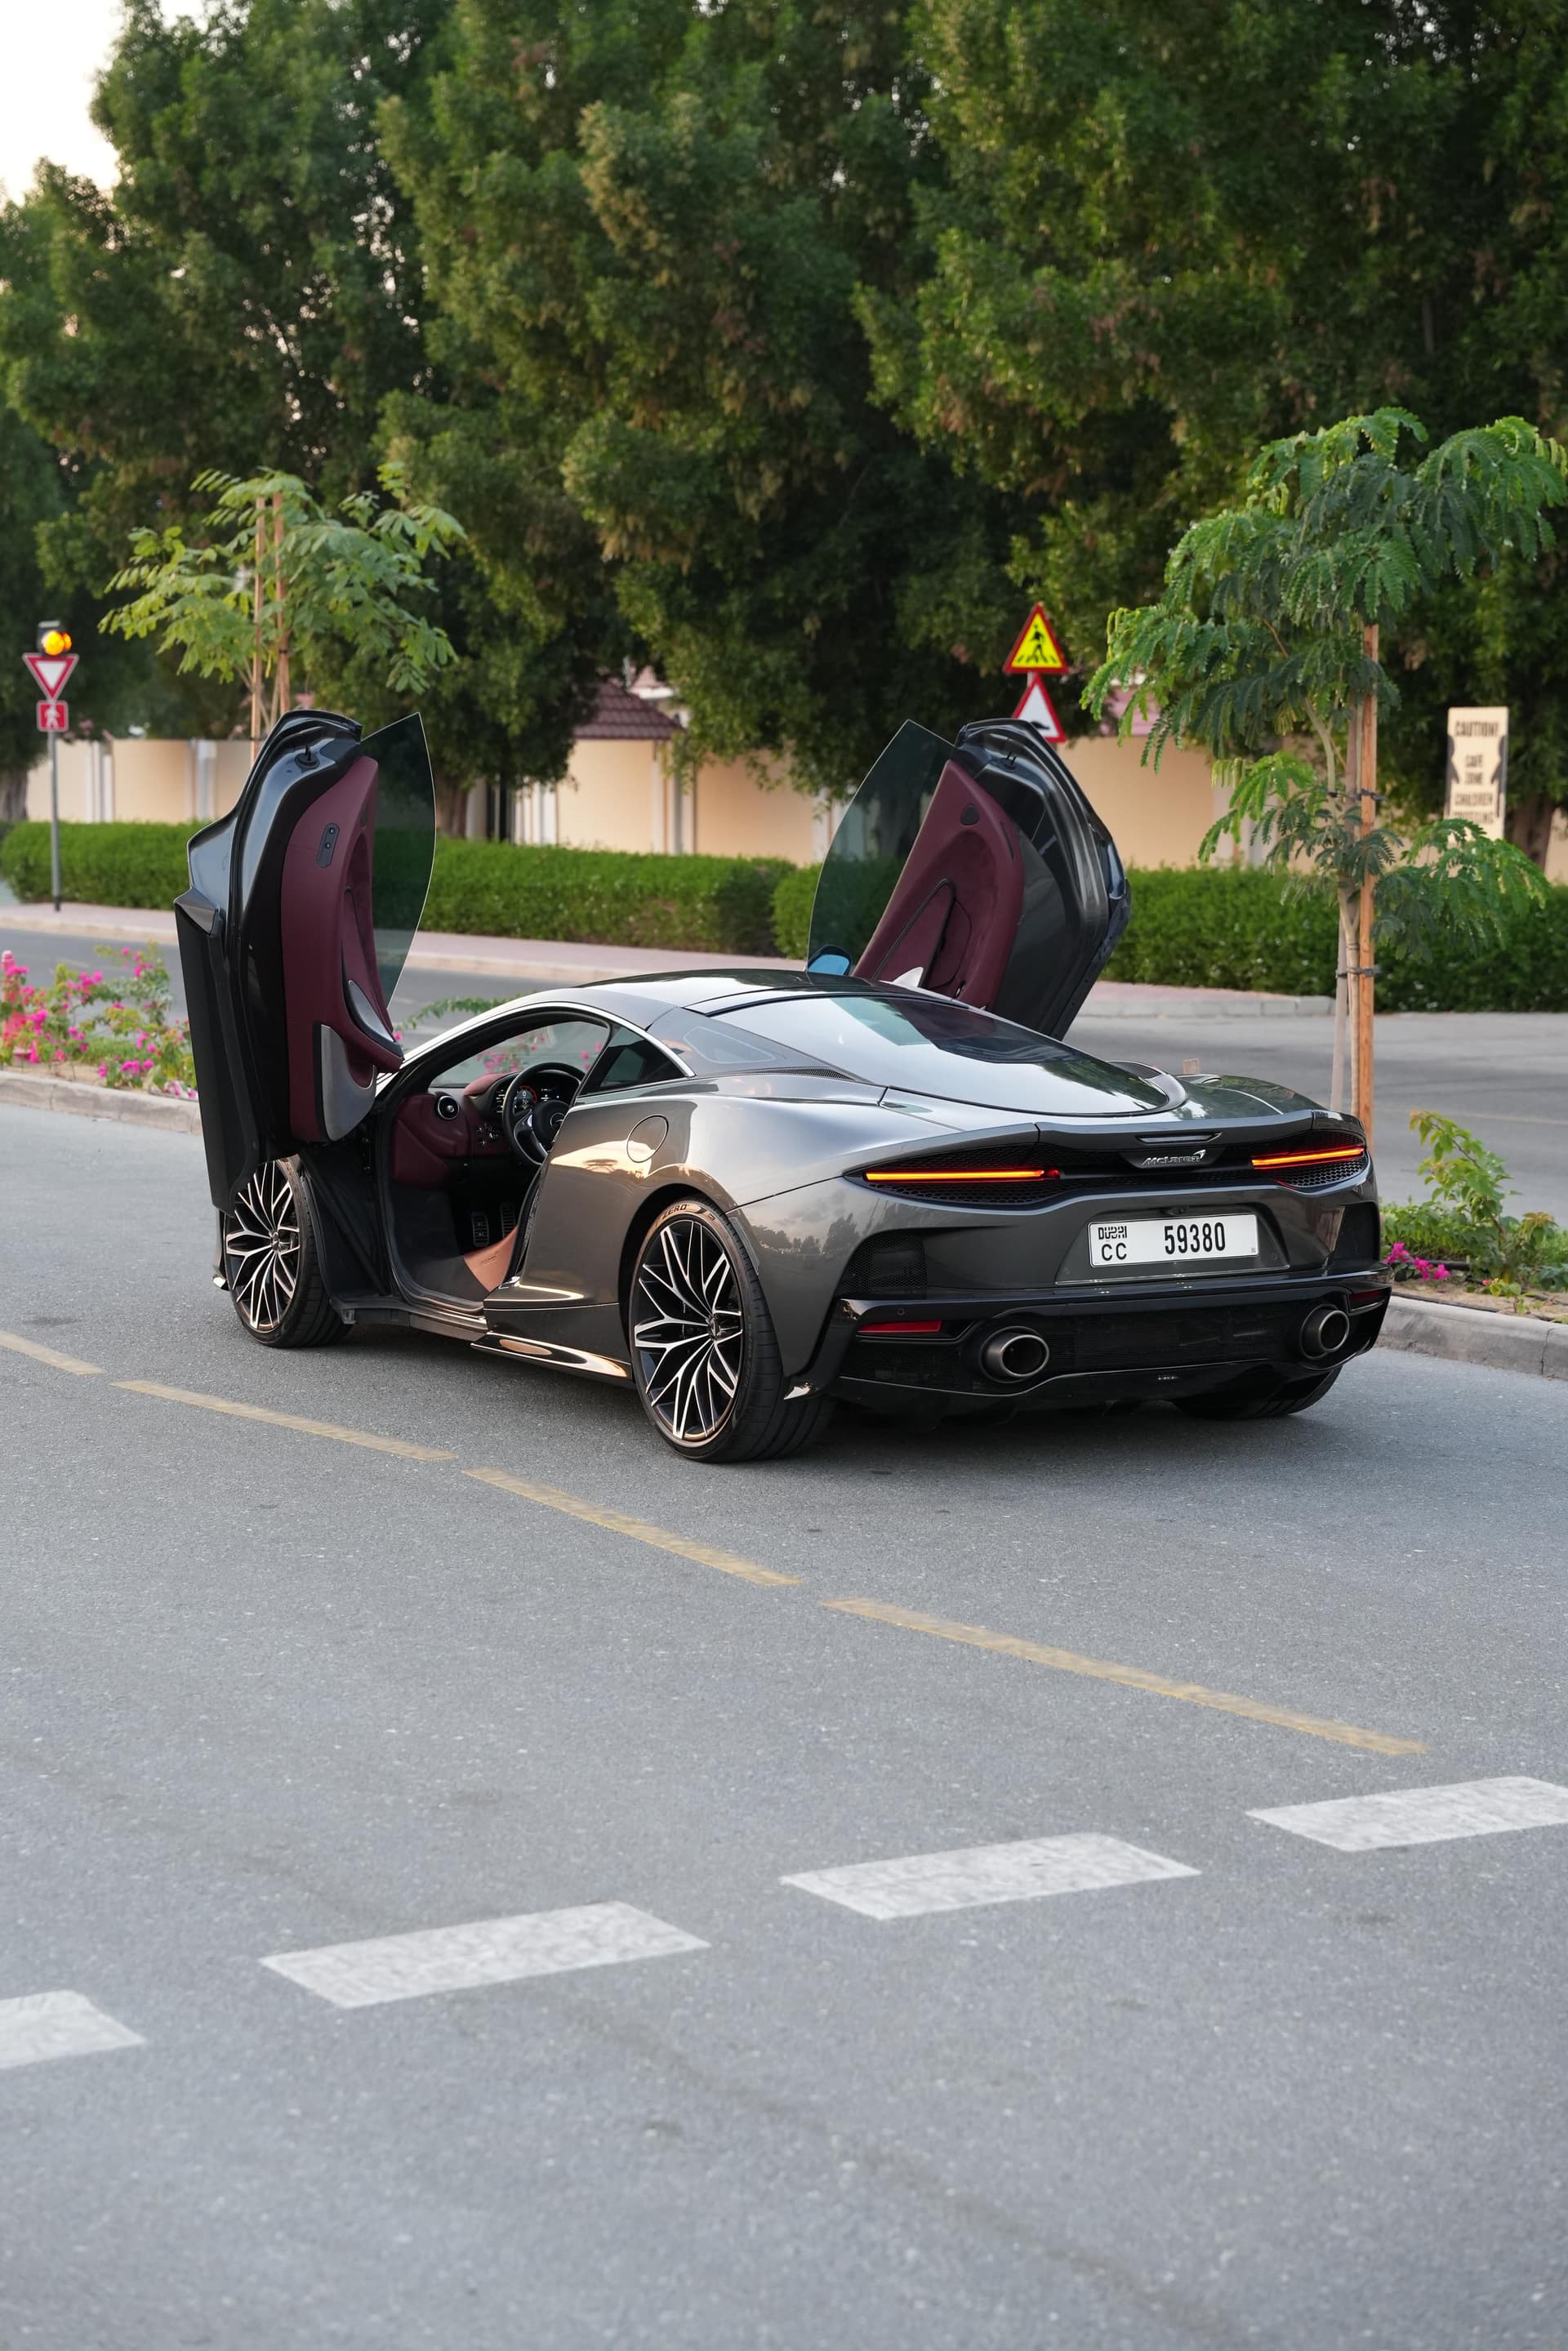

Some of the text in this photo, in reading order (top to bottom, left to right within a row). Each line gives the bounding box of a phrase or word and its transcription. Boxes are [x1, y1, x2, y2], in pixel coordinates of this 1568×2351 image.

[1142, 1155, 1200, 1166] McLaren
[1098, 1226, 1128, 1240] DUBAI
[1164, 1222, 1226, 1254] 59380
[1101, 1243, 1127, 1261] CC
